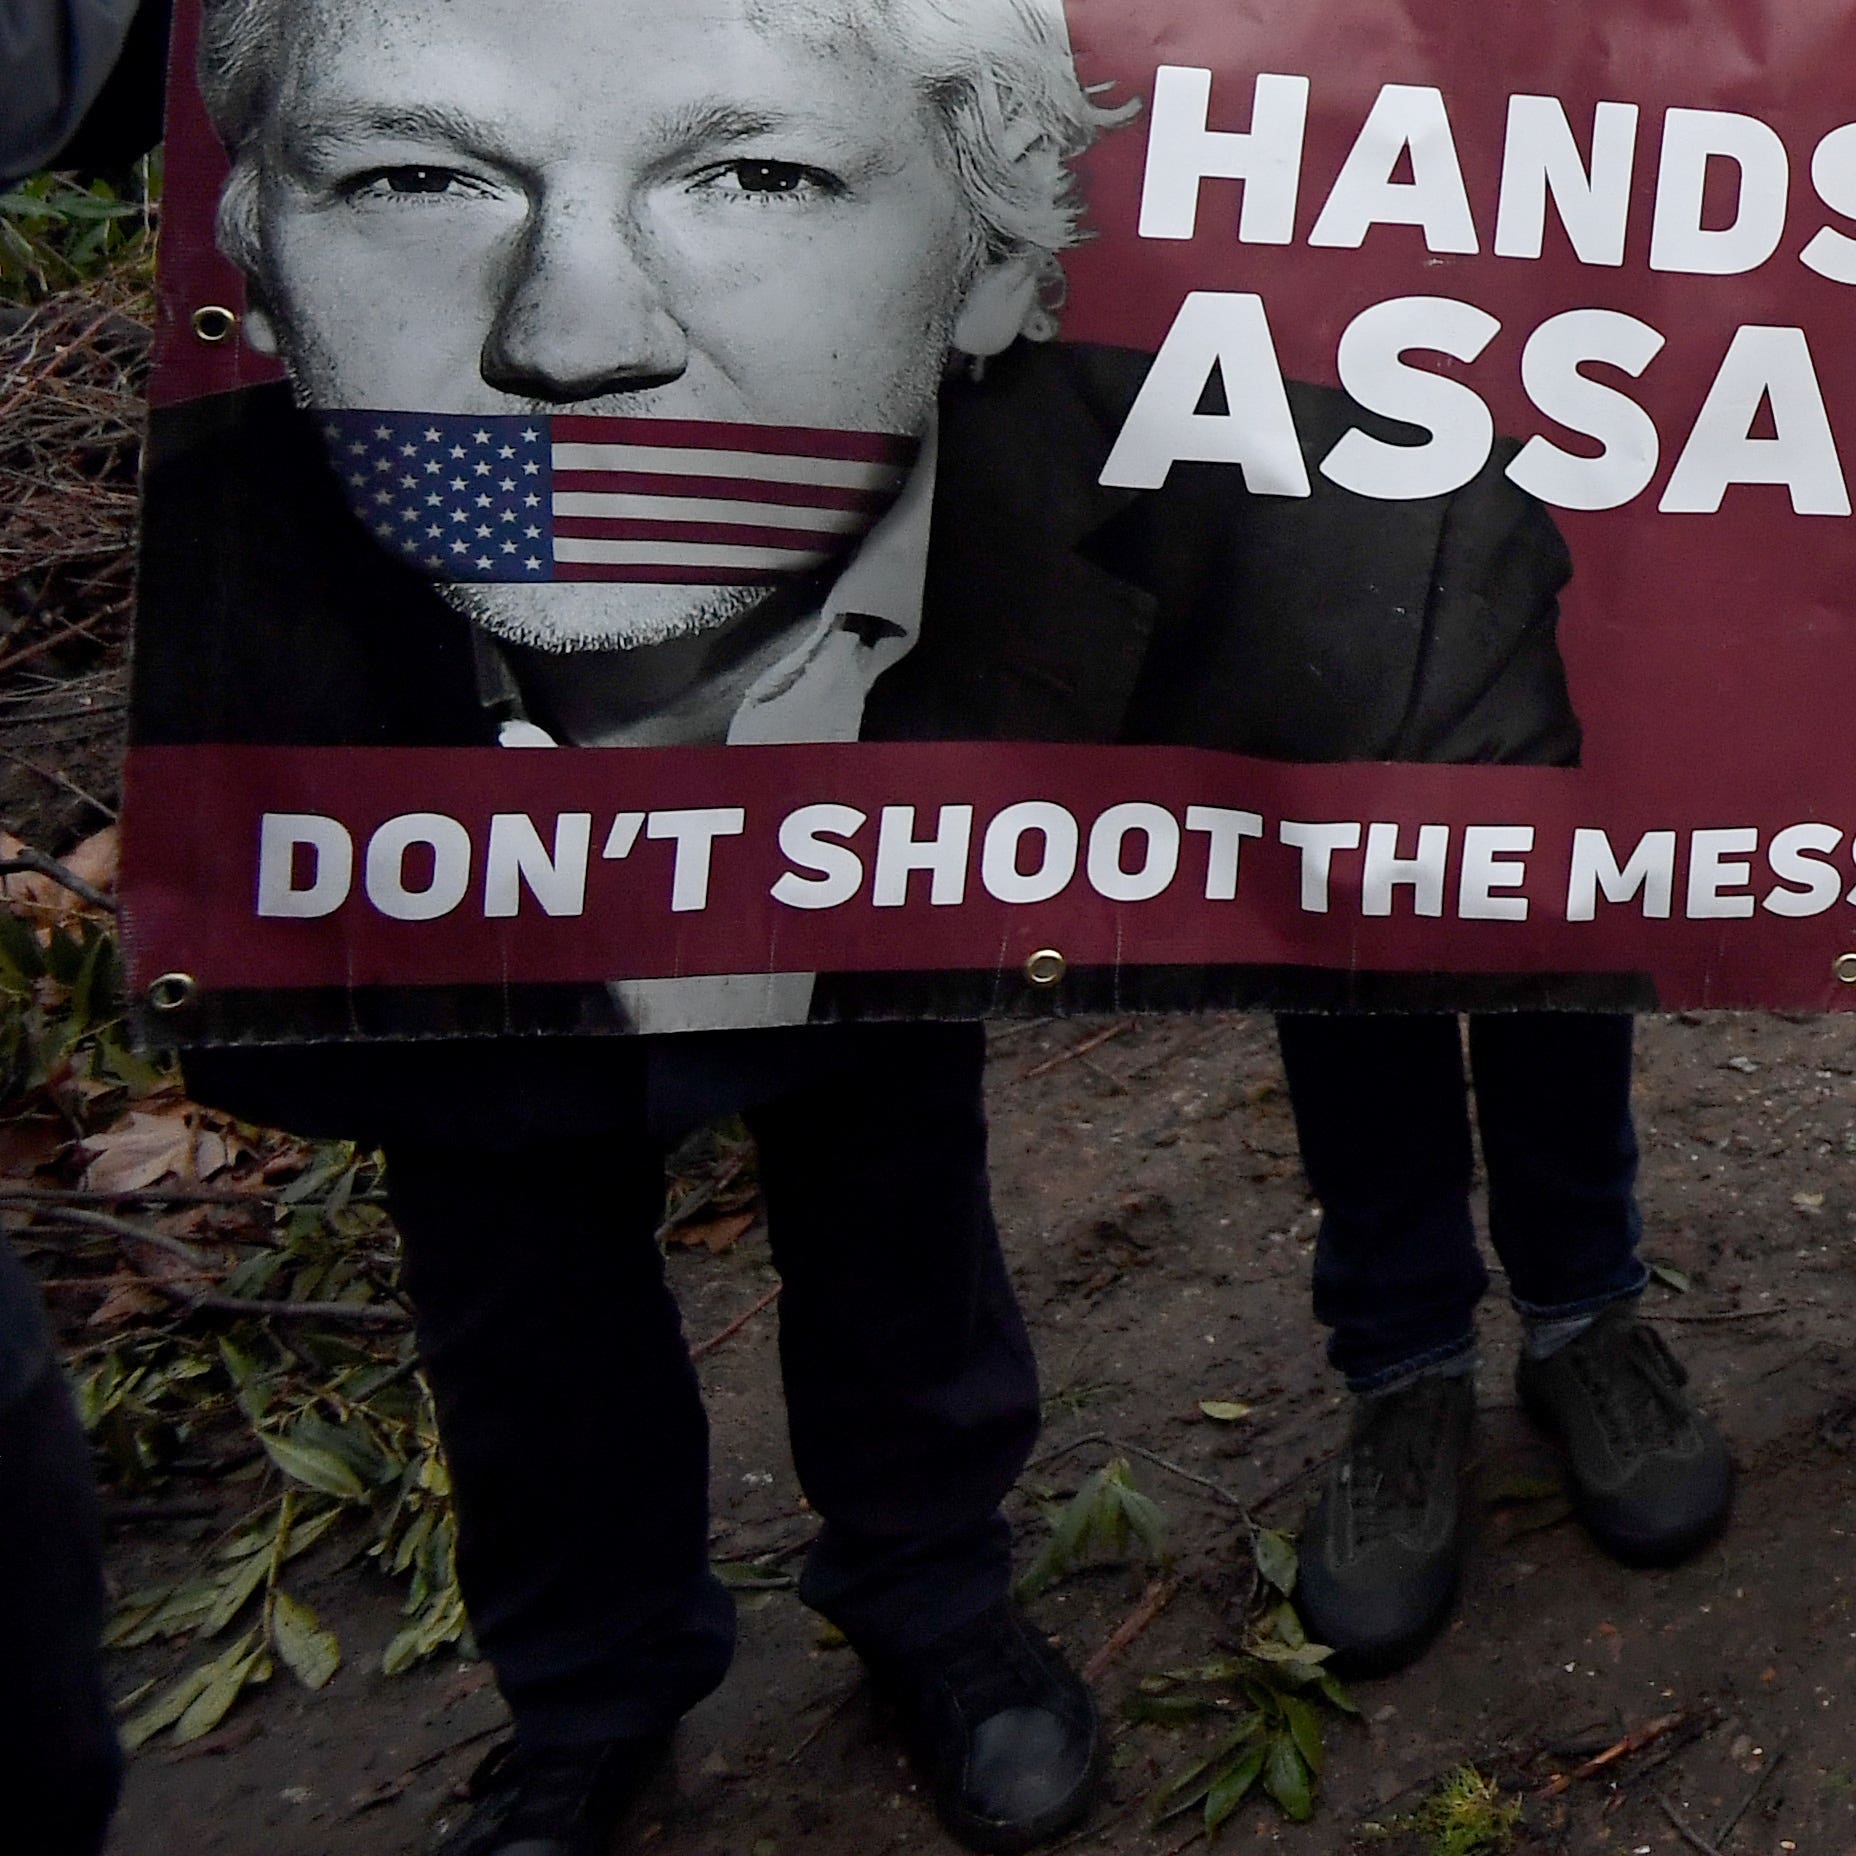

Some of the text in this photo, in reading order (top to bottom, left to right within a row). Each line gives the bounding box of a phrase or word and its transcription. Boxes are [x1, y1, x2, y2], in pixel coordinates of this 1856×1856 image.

[258, 808, 745, 920] DON'T
[770, 801, 1263, 909] SHOOT
[1280, 820, 1534, 921] THE
